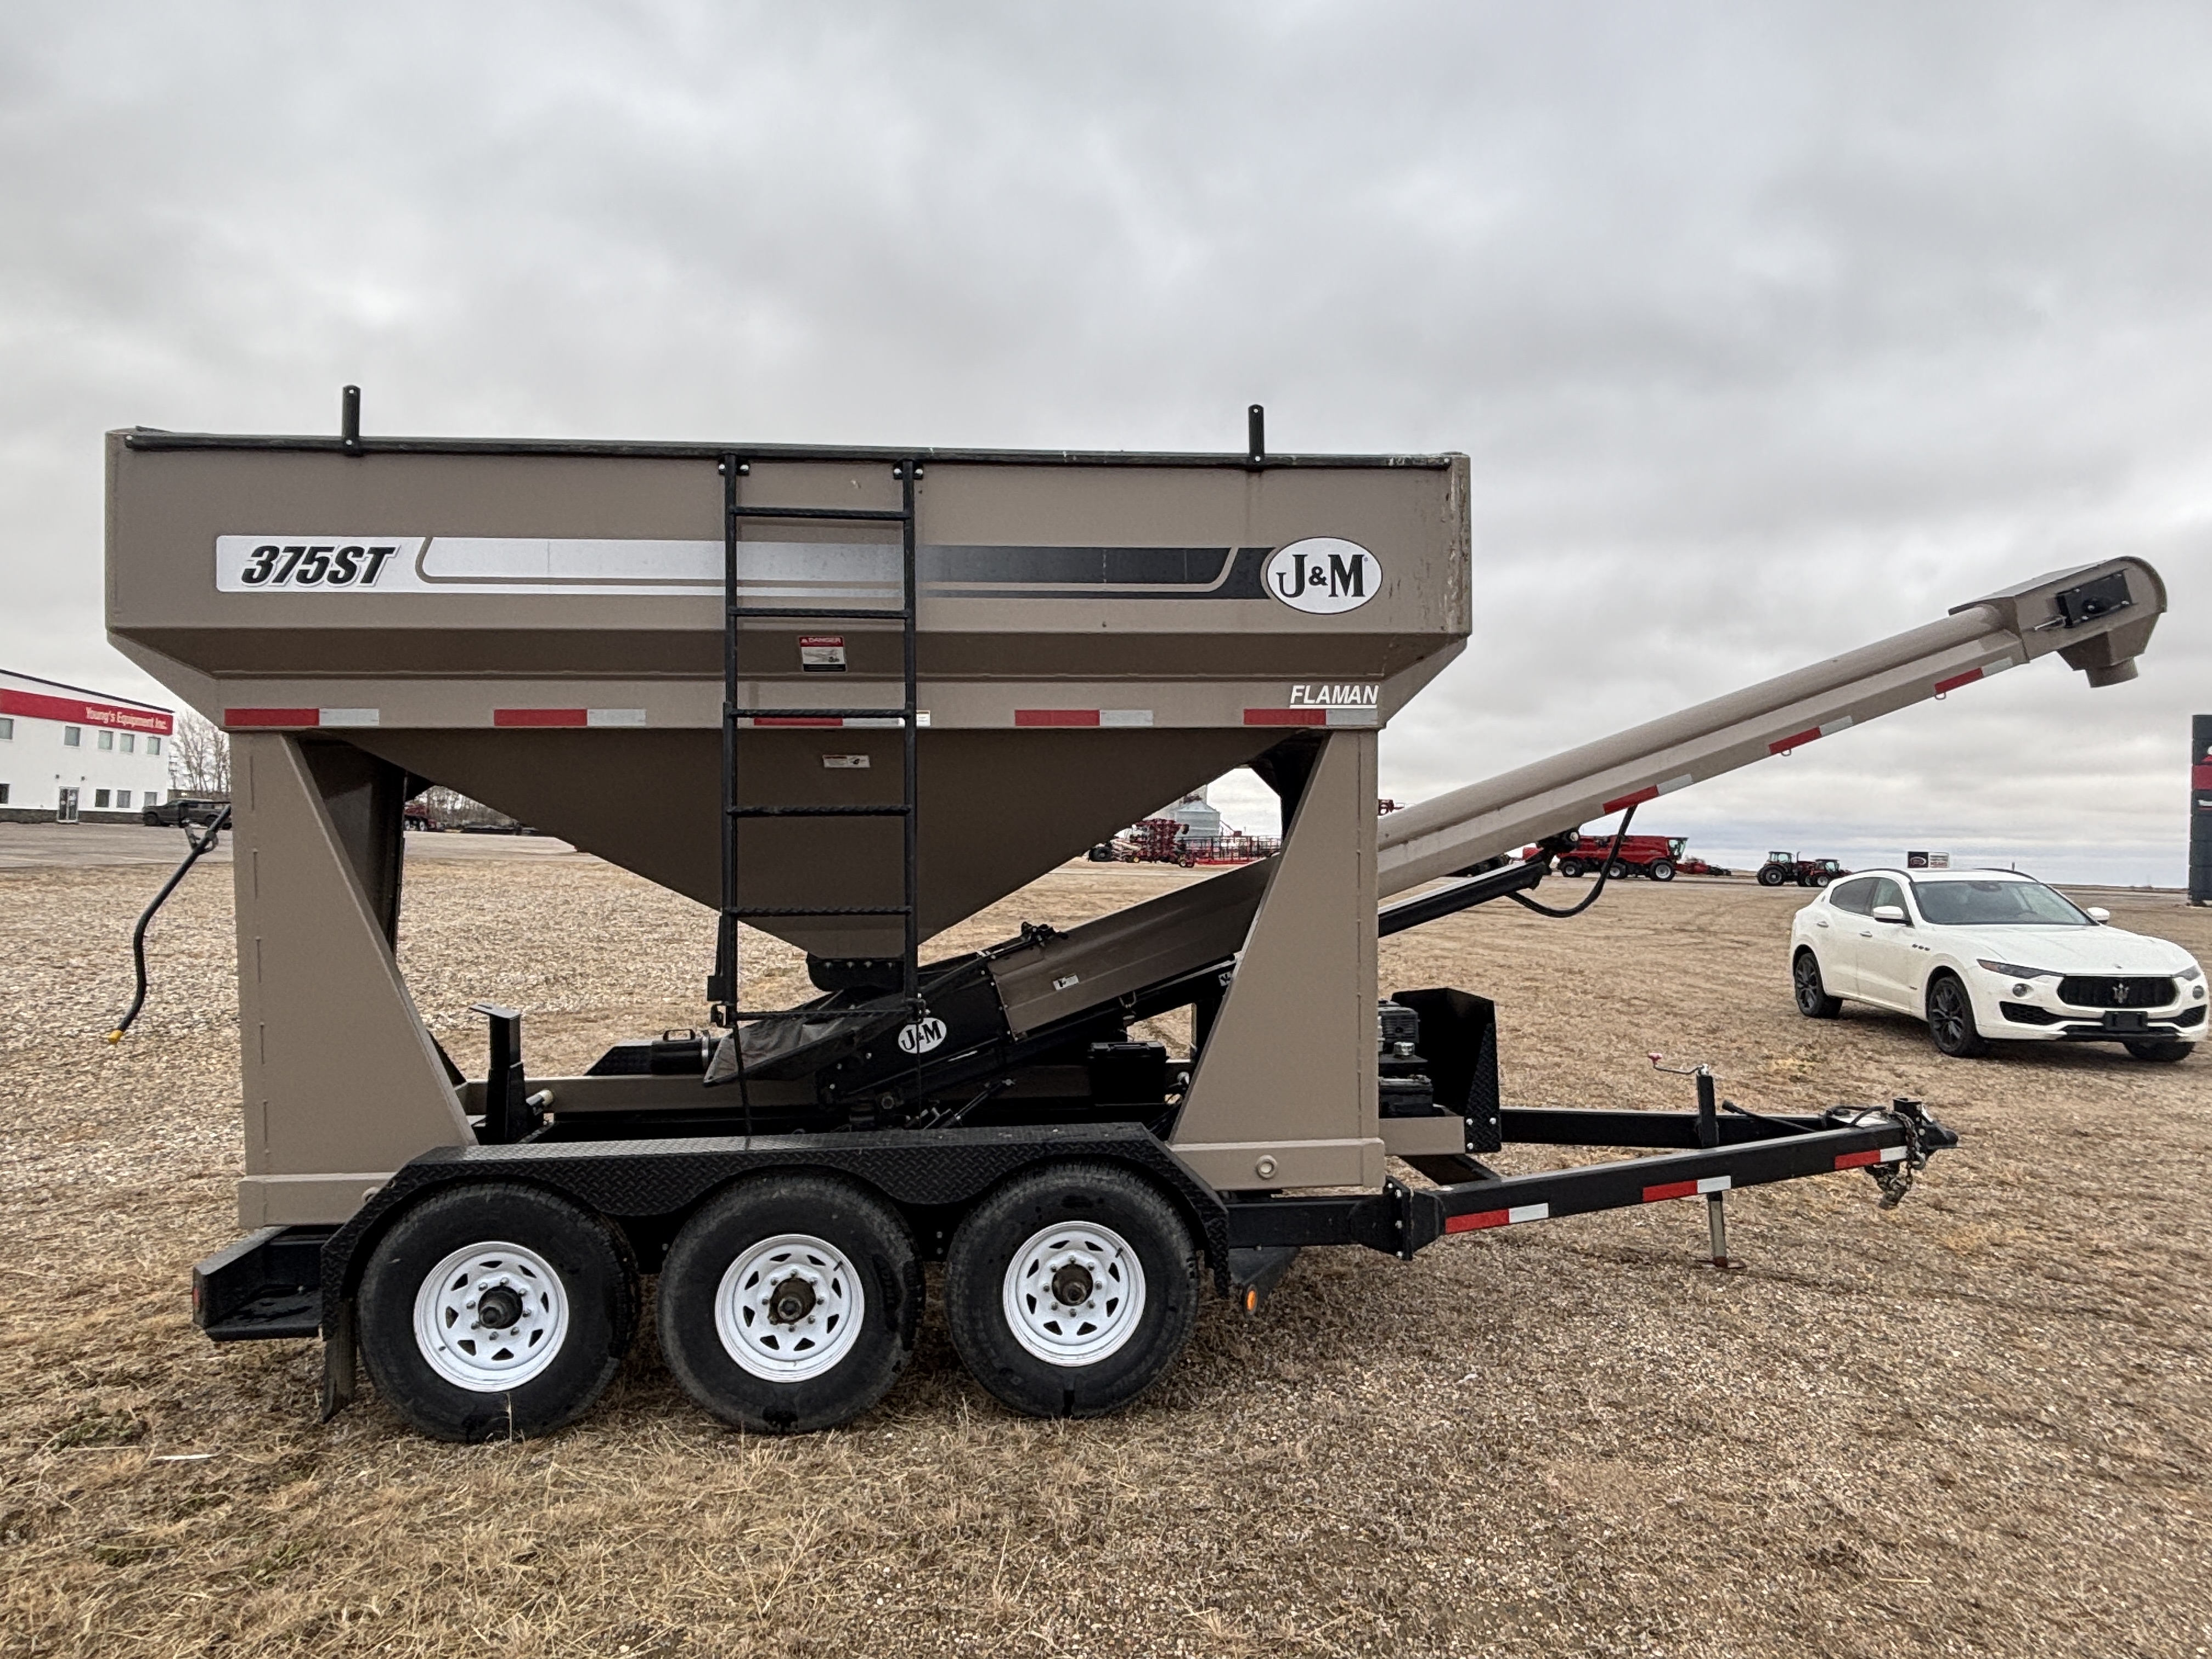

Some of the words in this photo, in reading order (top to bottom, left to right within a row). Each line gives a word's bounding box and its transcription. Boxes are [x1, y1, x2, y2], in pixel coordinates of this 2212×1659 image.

[240, 545, 397, 584] 375ST
[1276, 554, 1365, 598] J&M
[1290, 685, 1379, 704] FLAMAN
[86, 707, 115, 724] Young's
[116, 711, 154, 728] Equipment
